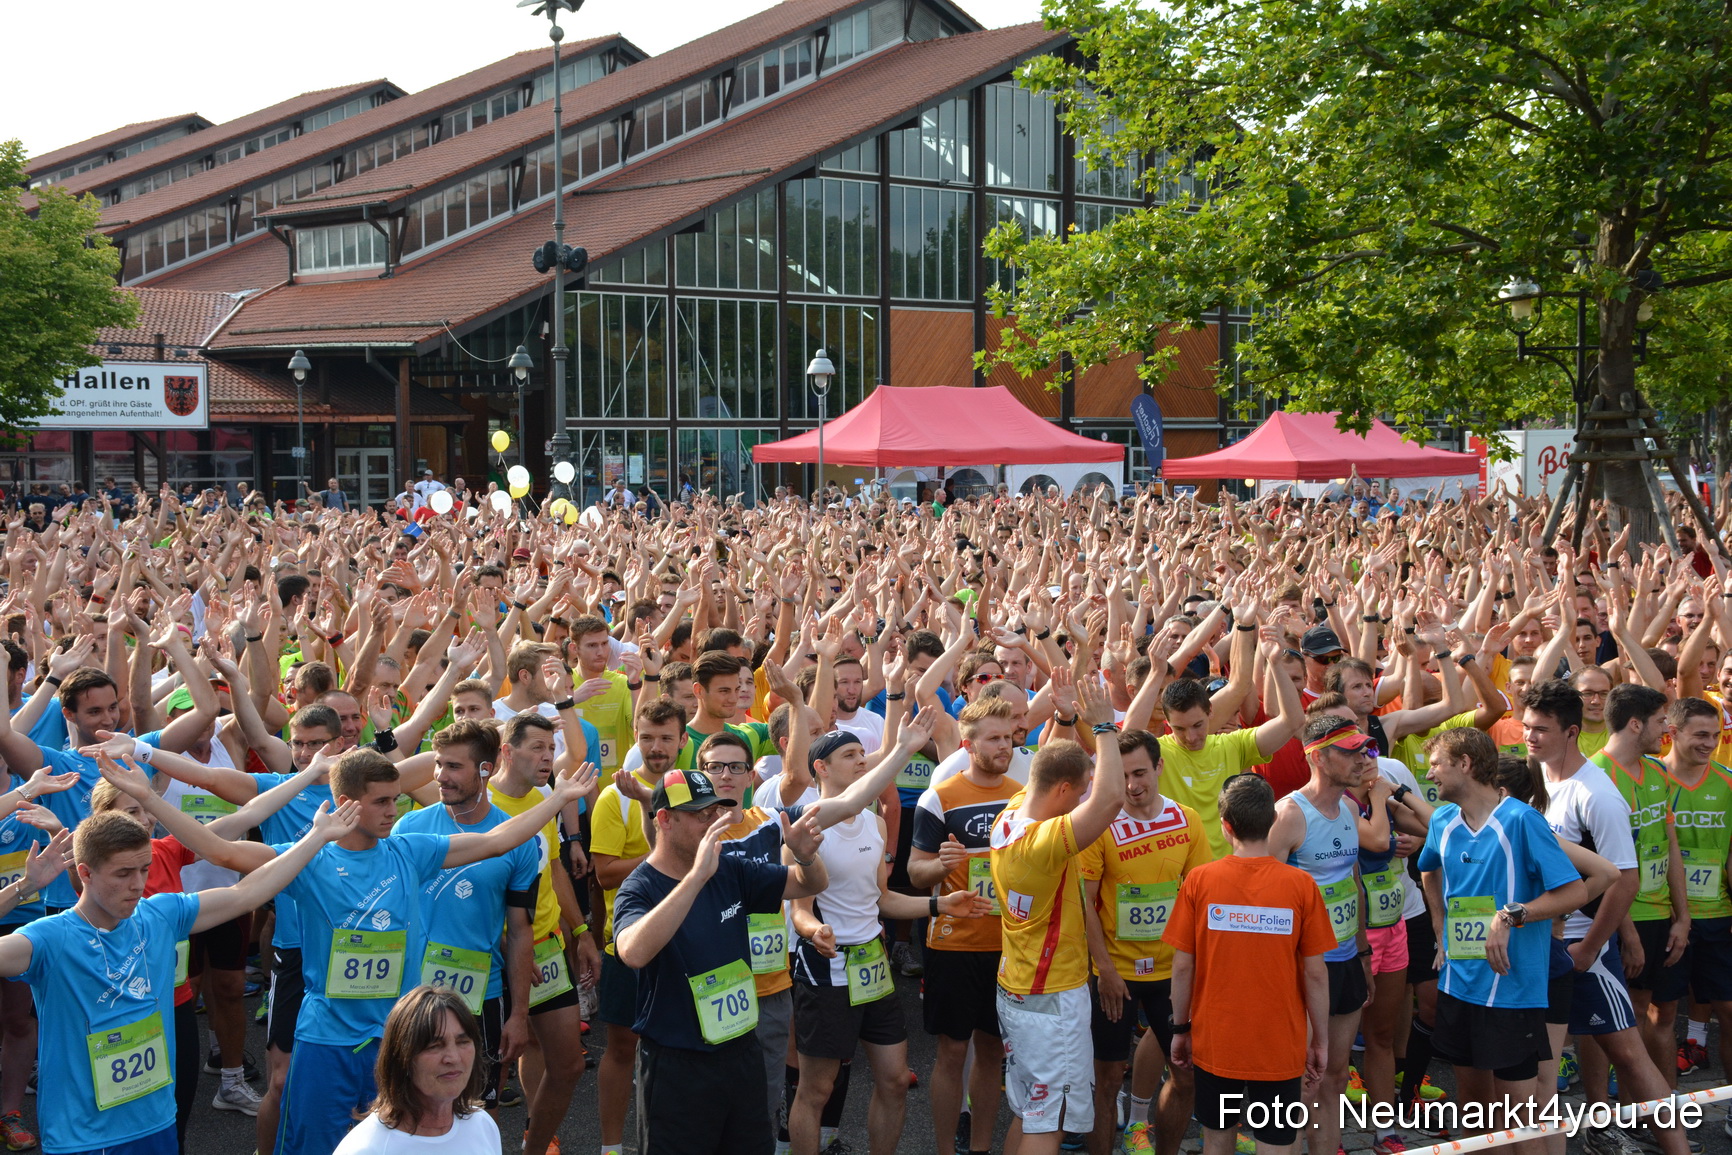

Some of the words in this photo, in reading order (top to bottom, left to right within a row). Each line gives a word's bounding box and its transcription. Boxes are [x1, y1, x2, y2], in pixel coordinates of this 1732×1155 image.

[62, 371, 150, 390] Hallen
[66, 410, 118, 418] angenehmen
[119, 410, 163, 418] Aufenthalt!
[89, 400, 111, 409] grüßt
[1538, 443, 1571, 478] Bö
[600, 743, 609, 757] 9
[904, 763, 931, 777] 450
[1426, 788, 1437, 801] 6
[1674, 811, 1726, 828] OCK
[1118, 842, 1153, 862] MAX
[1156, 833, 1191, 851] BÖGL
[425, 874, 445, 895] Team
[1684, 869, 1712, 886] 47
[357, 885, 382, 909] Schick
[380, 873, 398, 888] Bau
[975, 880, 997, 899] 16
[1380, 888, 1402, 910] 936
[1129, 905, 1167, 926] 832
[1229, 912, 1291, 926] PEKUFolien
[1454, 921, 1487, 942] 522
[750, 933, 784, 956] 623
[113, 955, 135, 981] Shick
[344, 958, 390, 980] 819
[541, 961, 559, 984] 60
[859, 961, 886, 987] 972
[431, 970, 474, 995] 810
[711, 989, 749, 1022] 708
[111, 1047, 156, 1083] 820
